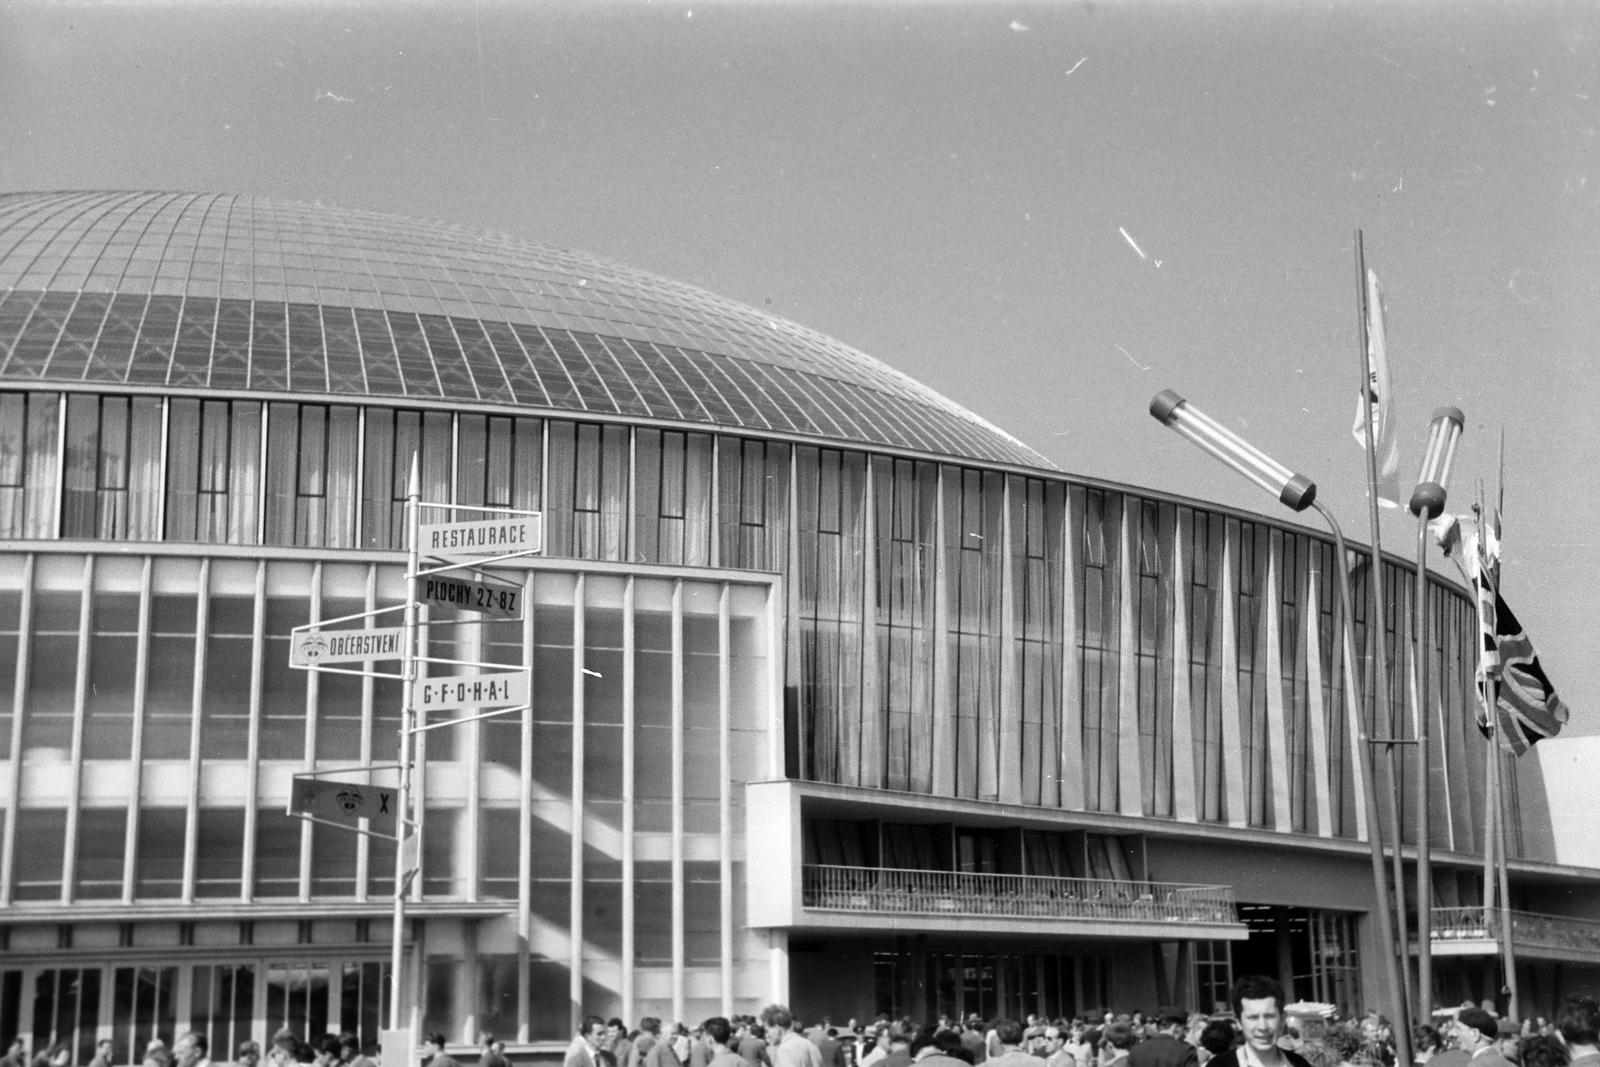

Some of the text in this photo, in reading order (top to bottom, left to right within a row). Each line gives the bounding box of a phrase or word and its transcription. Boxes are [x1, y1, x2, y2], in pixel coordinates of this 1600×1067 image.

[432, 524, 526, 549] RESTAURACE
[426, 580, 471, 605] PLOCHY
[330, 632, 400, 656] OBČERSTVENÍ
